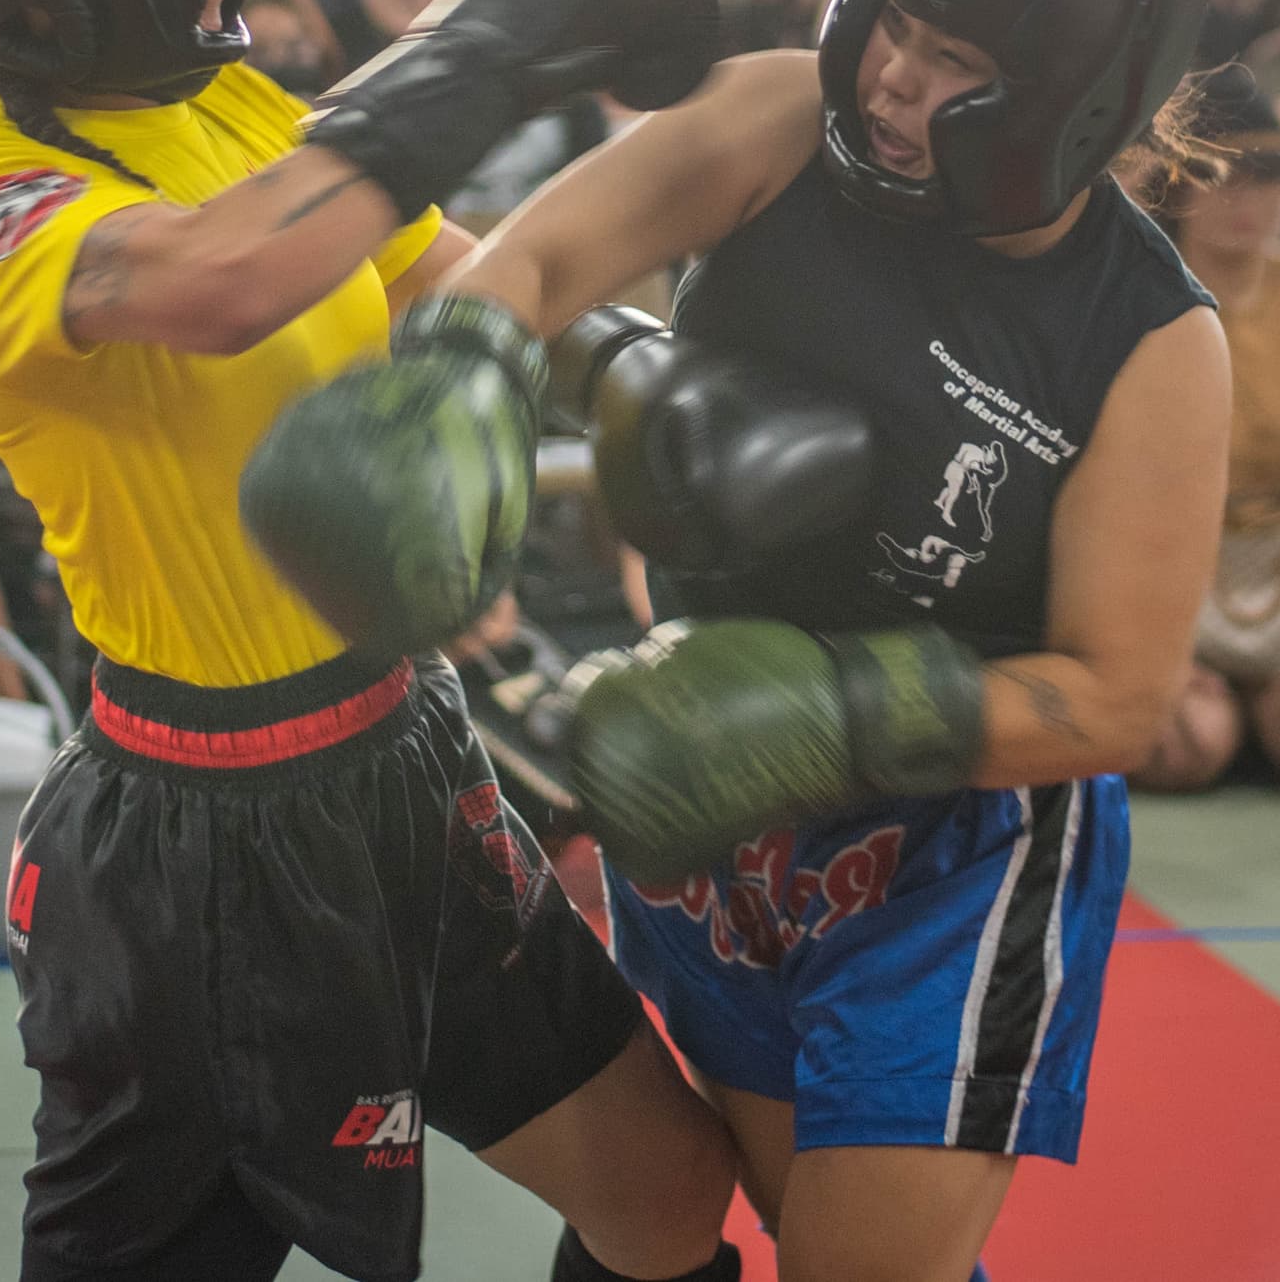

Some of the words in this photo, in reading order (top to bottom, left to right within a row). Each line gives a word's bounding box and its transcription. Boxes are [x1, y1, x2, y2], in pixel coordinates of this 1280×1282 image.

[929, 339, 1020, 415] Concepcion
[943, 381, 966, 399] of
[963, 396, 1028, 443] Martial
[1023, 436, 1060, 465] Arts
